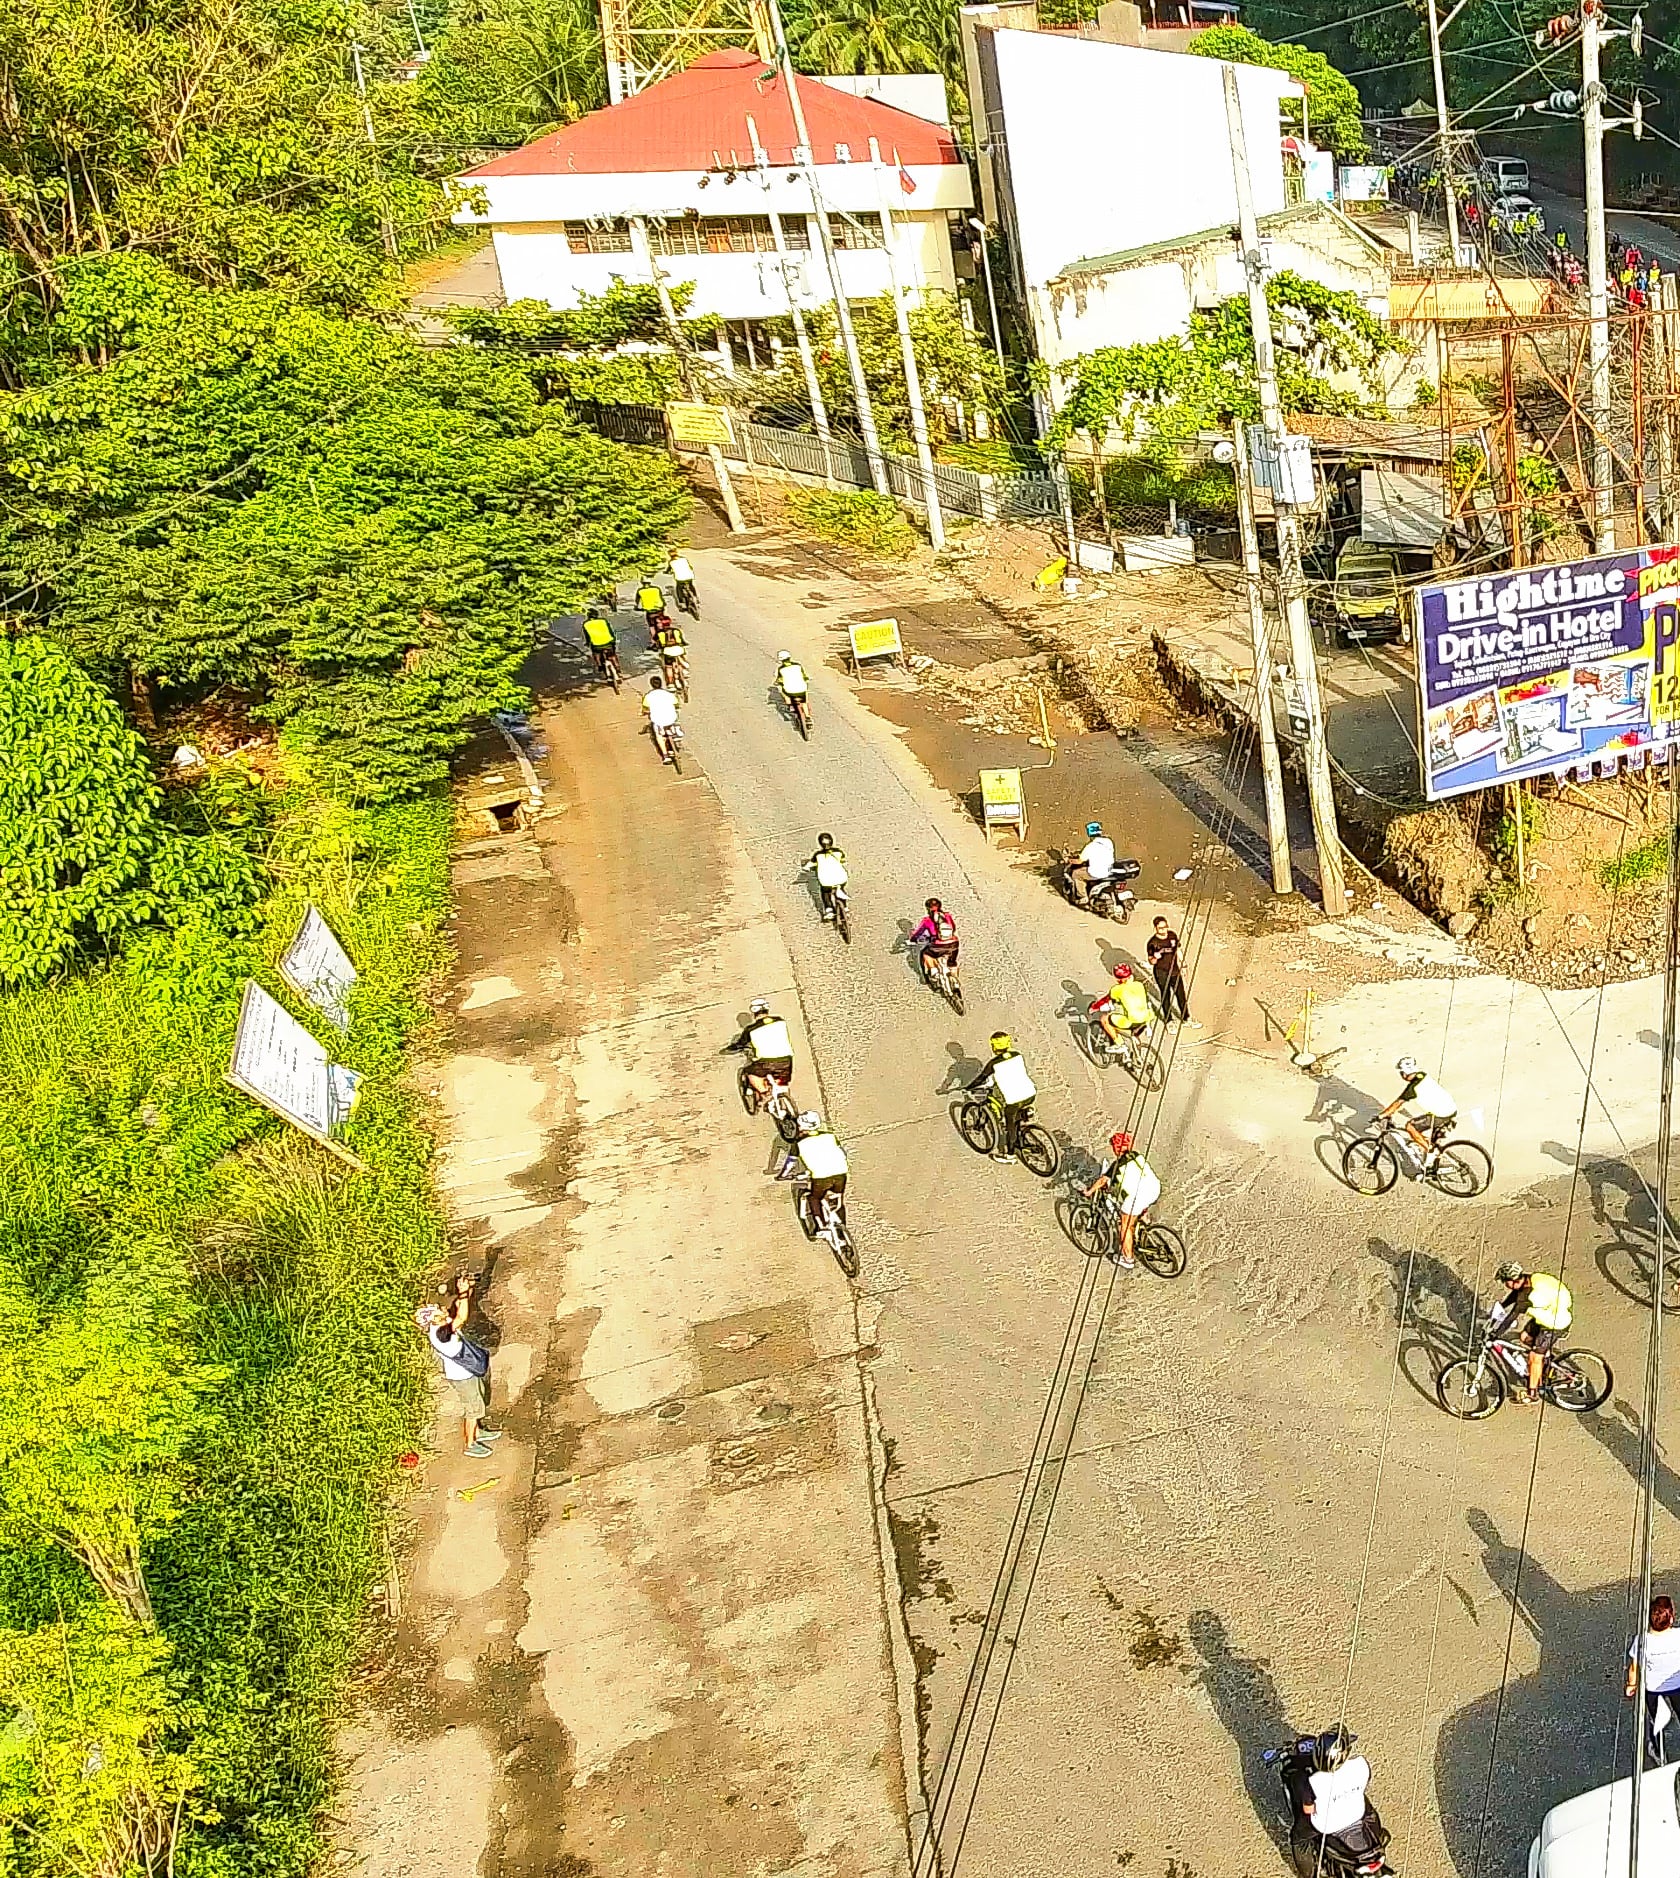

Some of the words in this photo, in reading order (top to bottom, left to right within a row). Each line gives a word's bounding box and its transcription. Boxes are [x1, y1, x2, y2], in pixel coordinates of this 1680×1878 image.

[1444, 568, 1626, 630] Hightime
[854, 626, 895, 642] CAUTION
[1437, 619, 1548, 665] Drive-in
[1549, 601, 1623, 643] Hotel
[1654, 676, 1679, 706] 12
